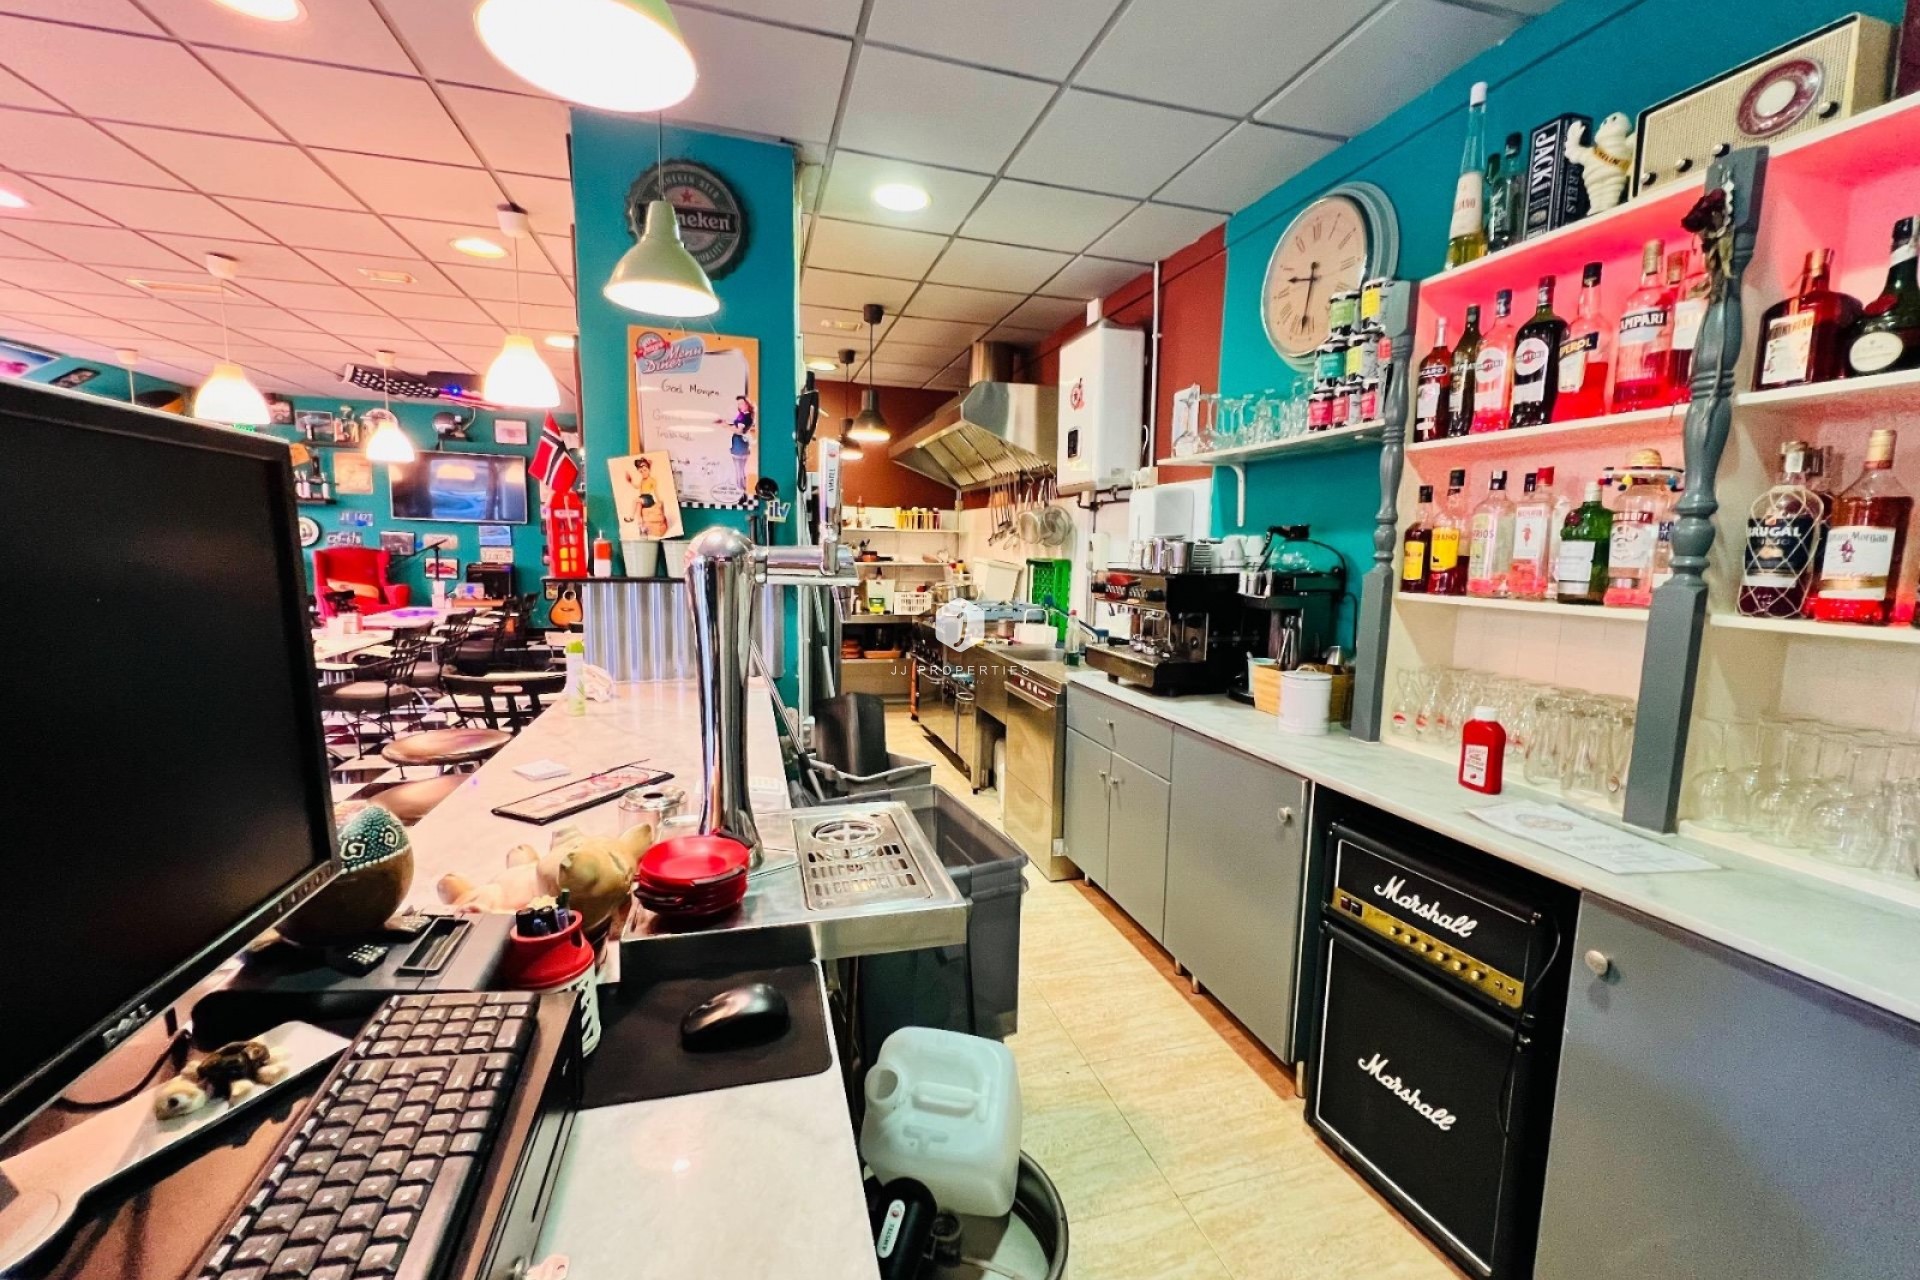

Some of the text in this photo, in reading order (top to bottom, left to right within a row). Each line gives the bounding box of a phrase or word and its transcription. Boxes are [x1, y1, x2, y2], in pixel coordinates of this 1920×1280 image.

[675, 211, 732, 231] neken
[1621, 313, 1664, 330] AMPARI
[1560, 338, 1592, 357] PEROL
[1374, 875, 1478, 938] Marshall
[1358, 1053, 1457, 1131] Marshall
